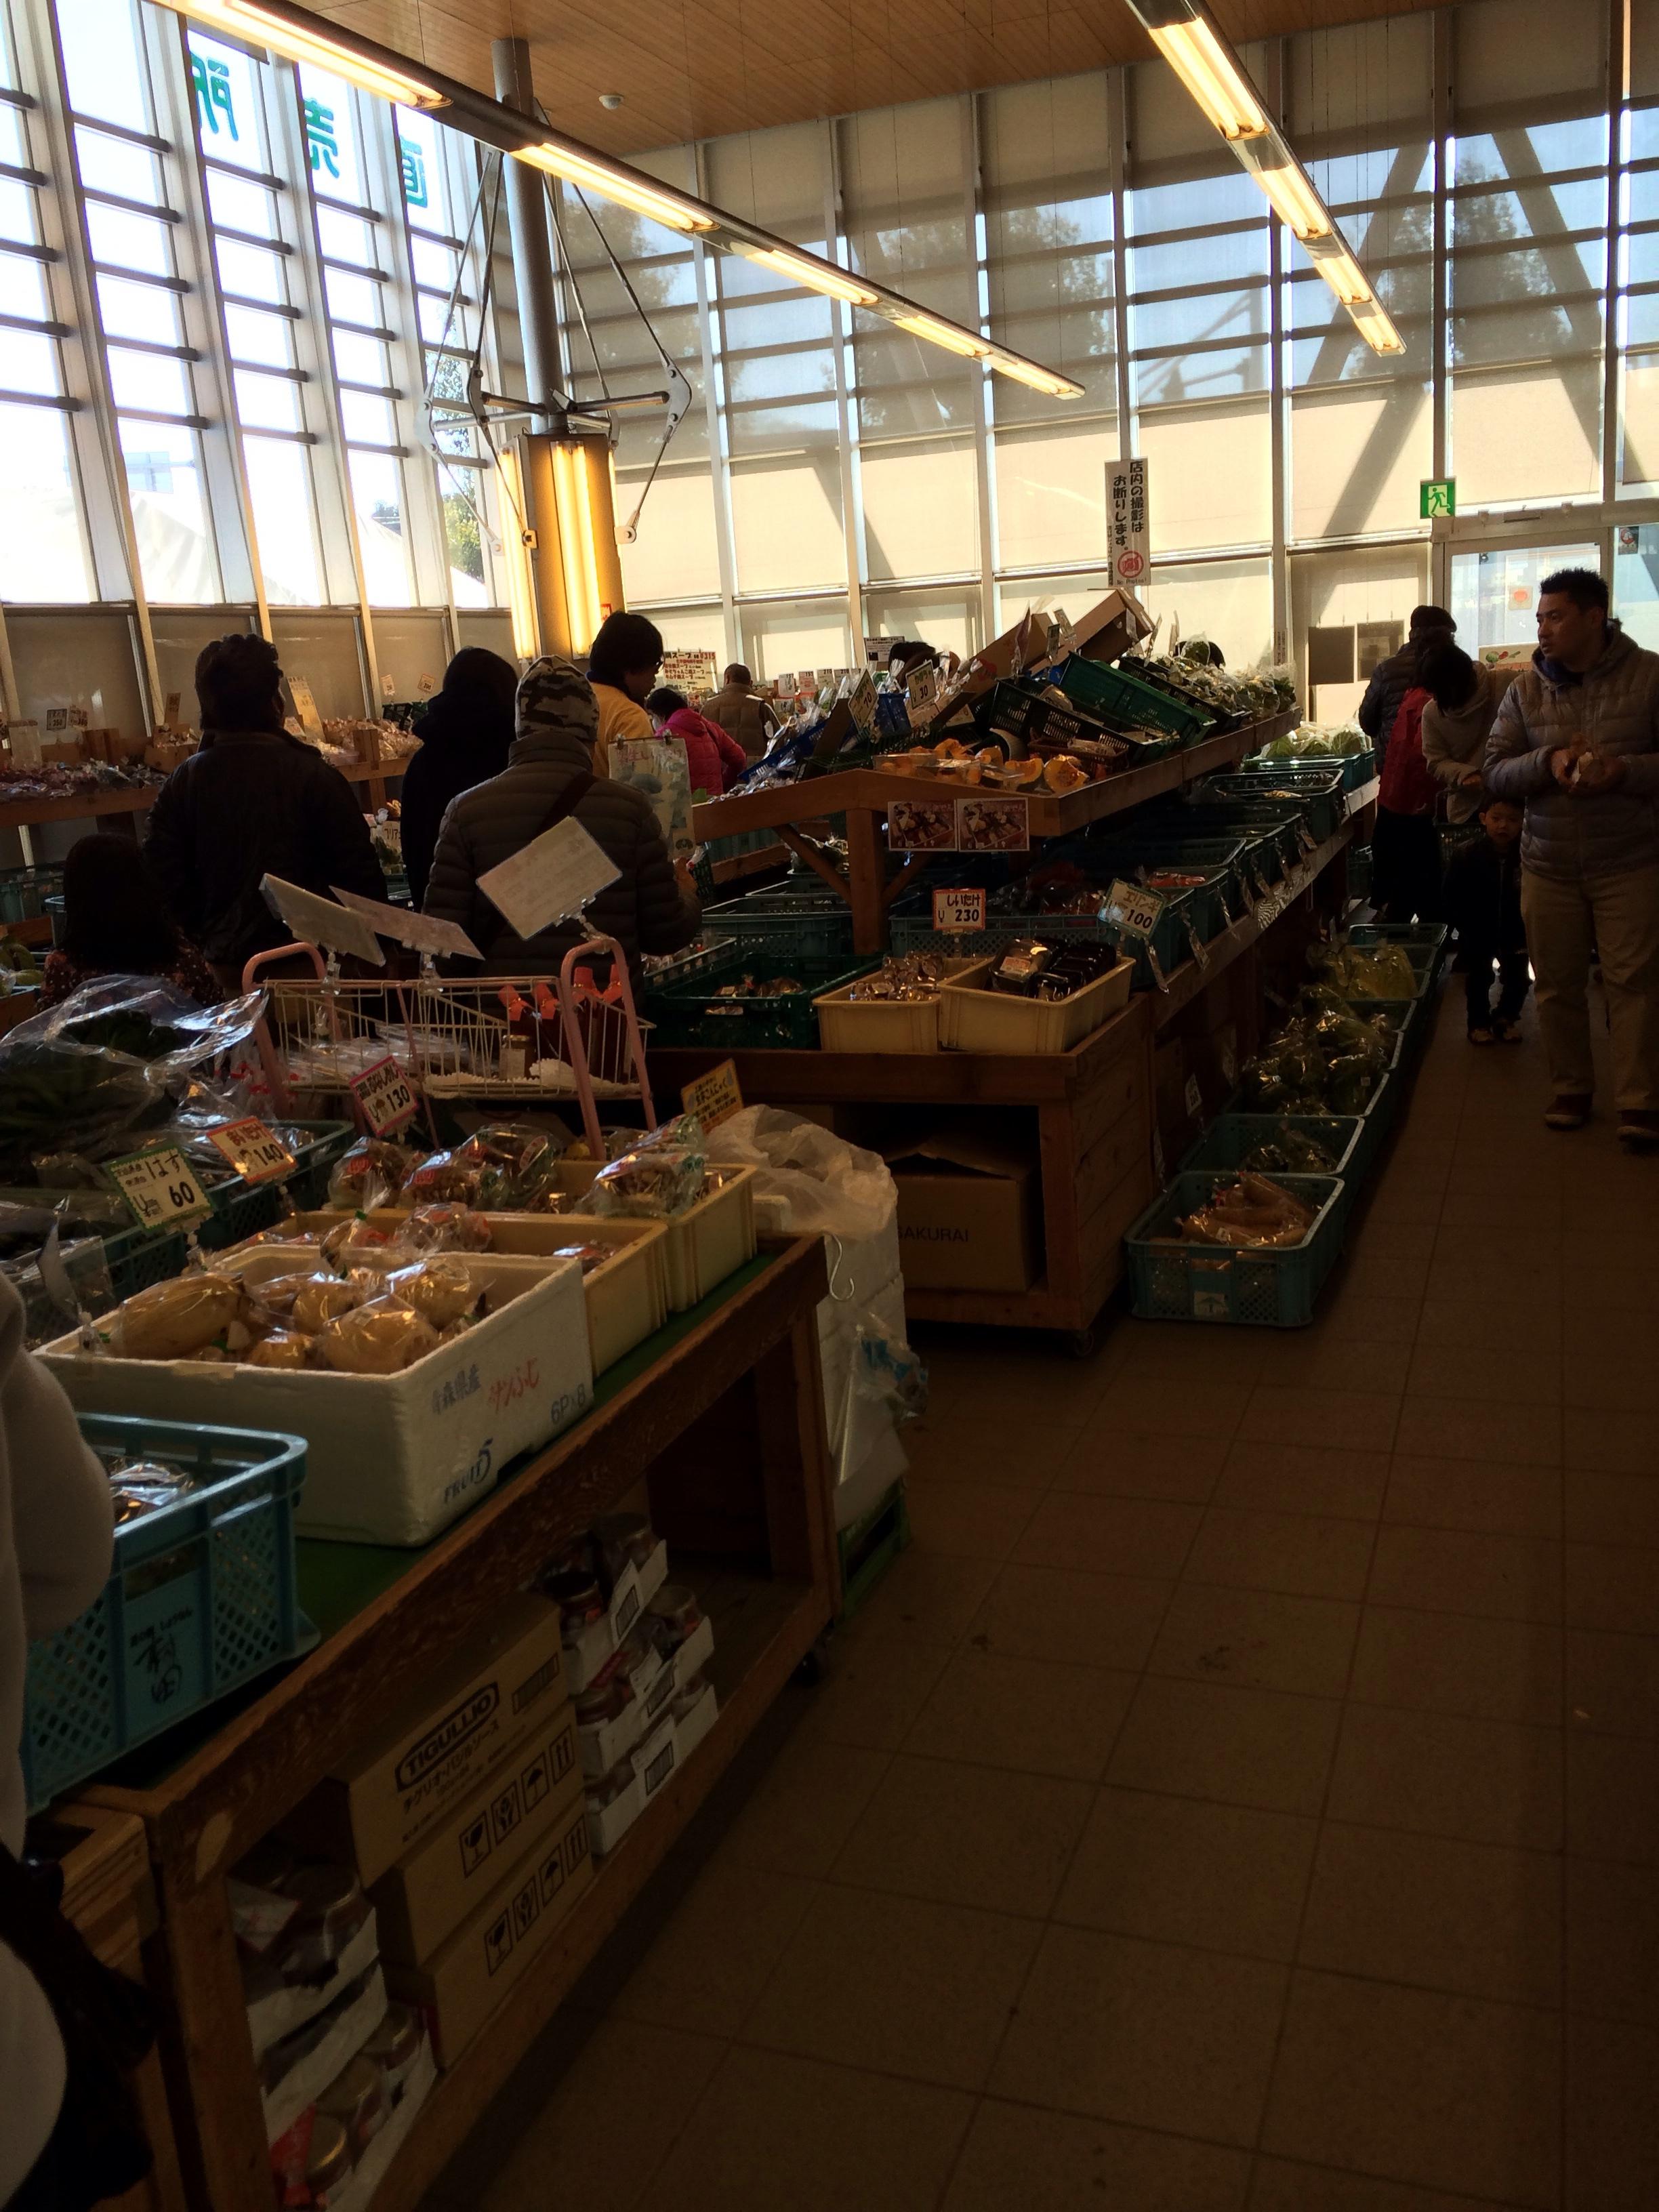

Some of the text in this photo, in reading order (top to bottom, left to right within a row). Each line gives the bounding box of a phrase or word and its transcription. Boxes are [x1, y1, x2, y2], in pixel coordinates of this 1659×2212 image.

[1130, 460, 1144, 533] 店内の撮影は
[947, 894, 981, 907] しいたけ
[1124, 890, 1160, 912] エリンギ
[955, 909, 979, 922] 230
[1127, 909, 1153, 928] 100
[386, 1084, 410, 1112] 130
[254, 1143, 285, 1166] 140
[169, 1181, 195, 1208] 60
[898, 1225, 969, 1242] SAKURAI
[405, 1694, 491, 1777] TIGULLIO
